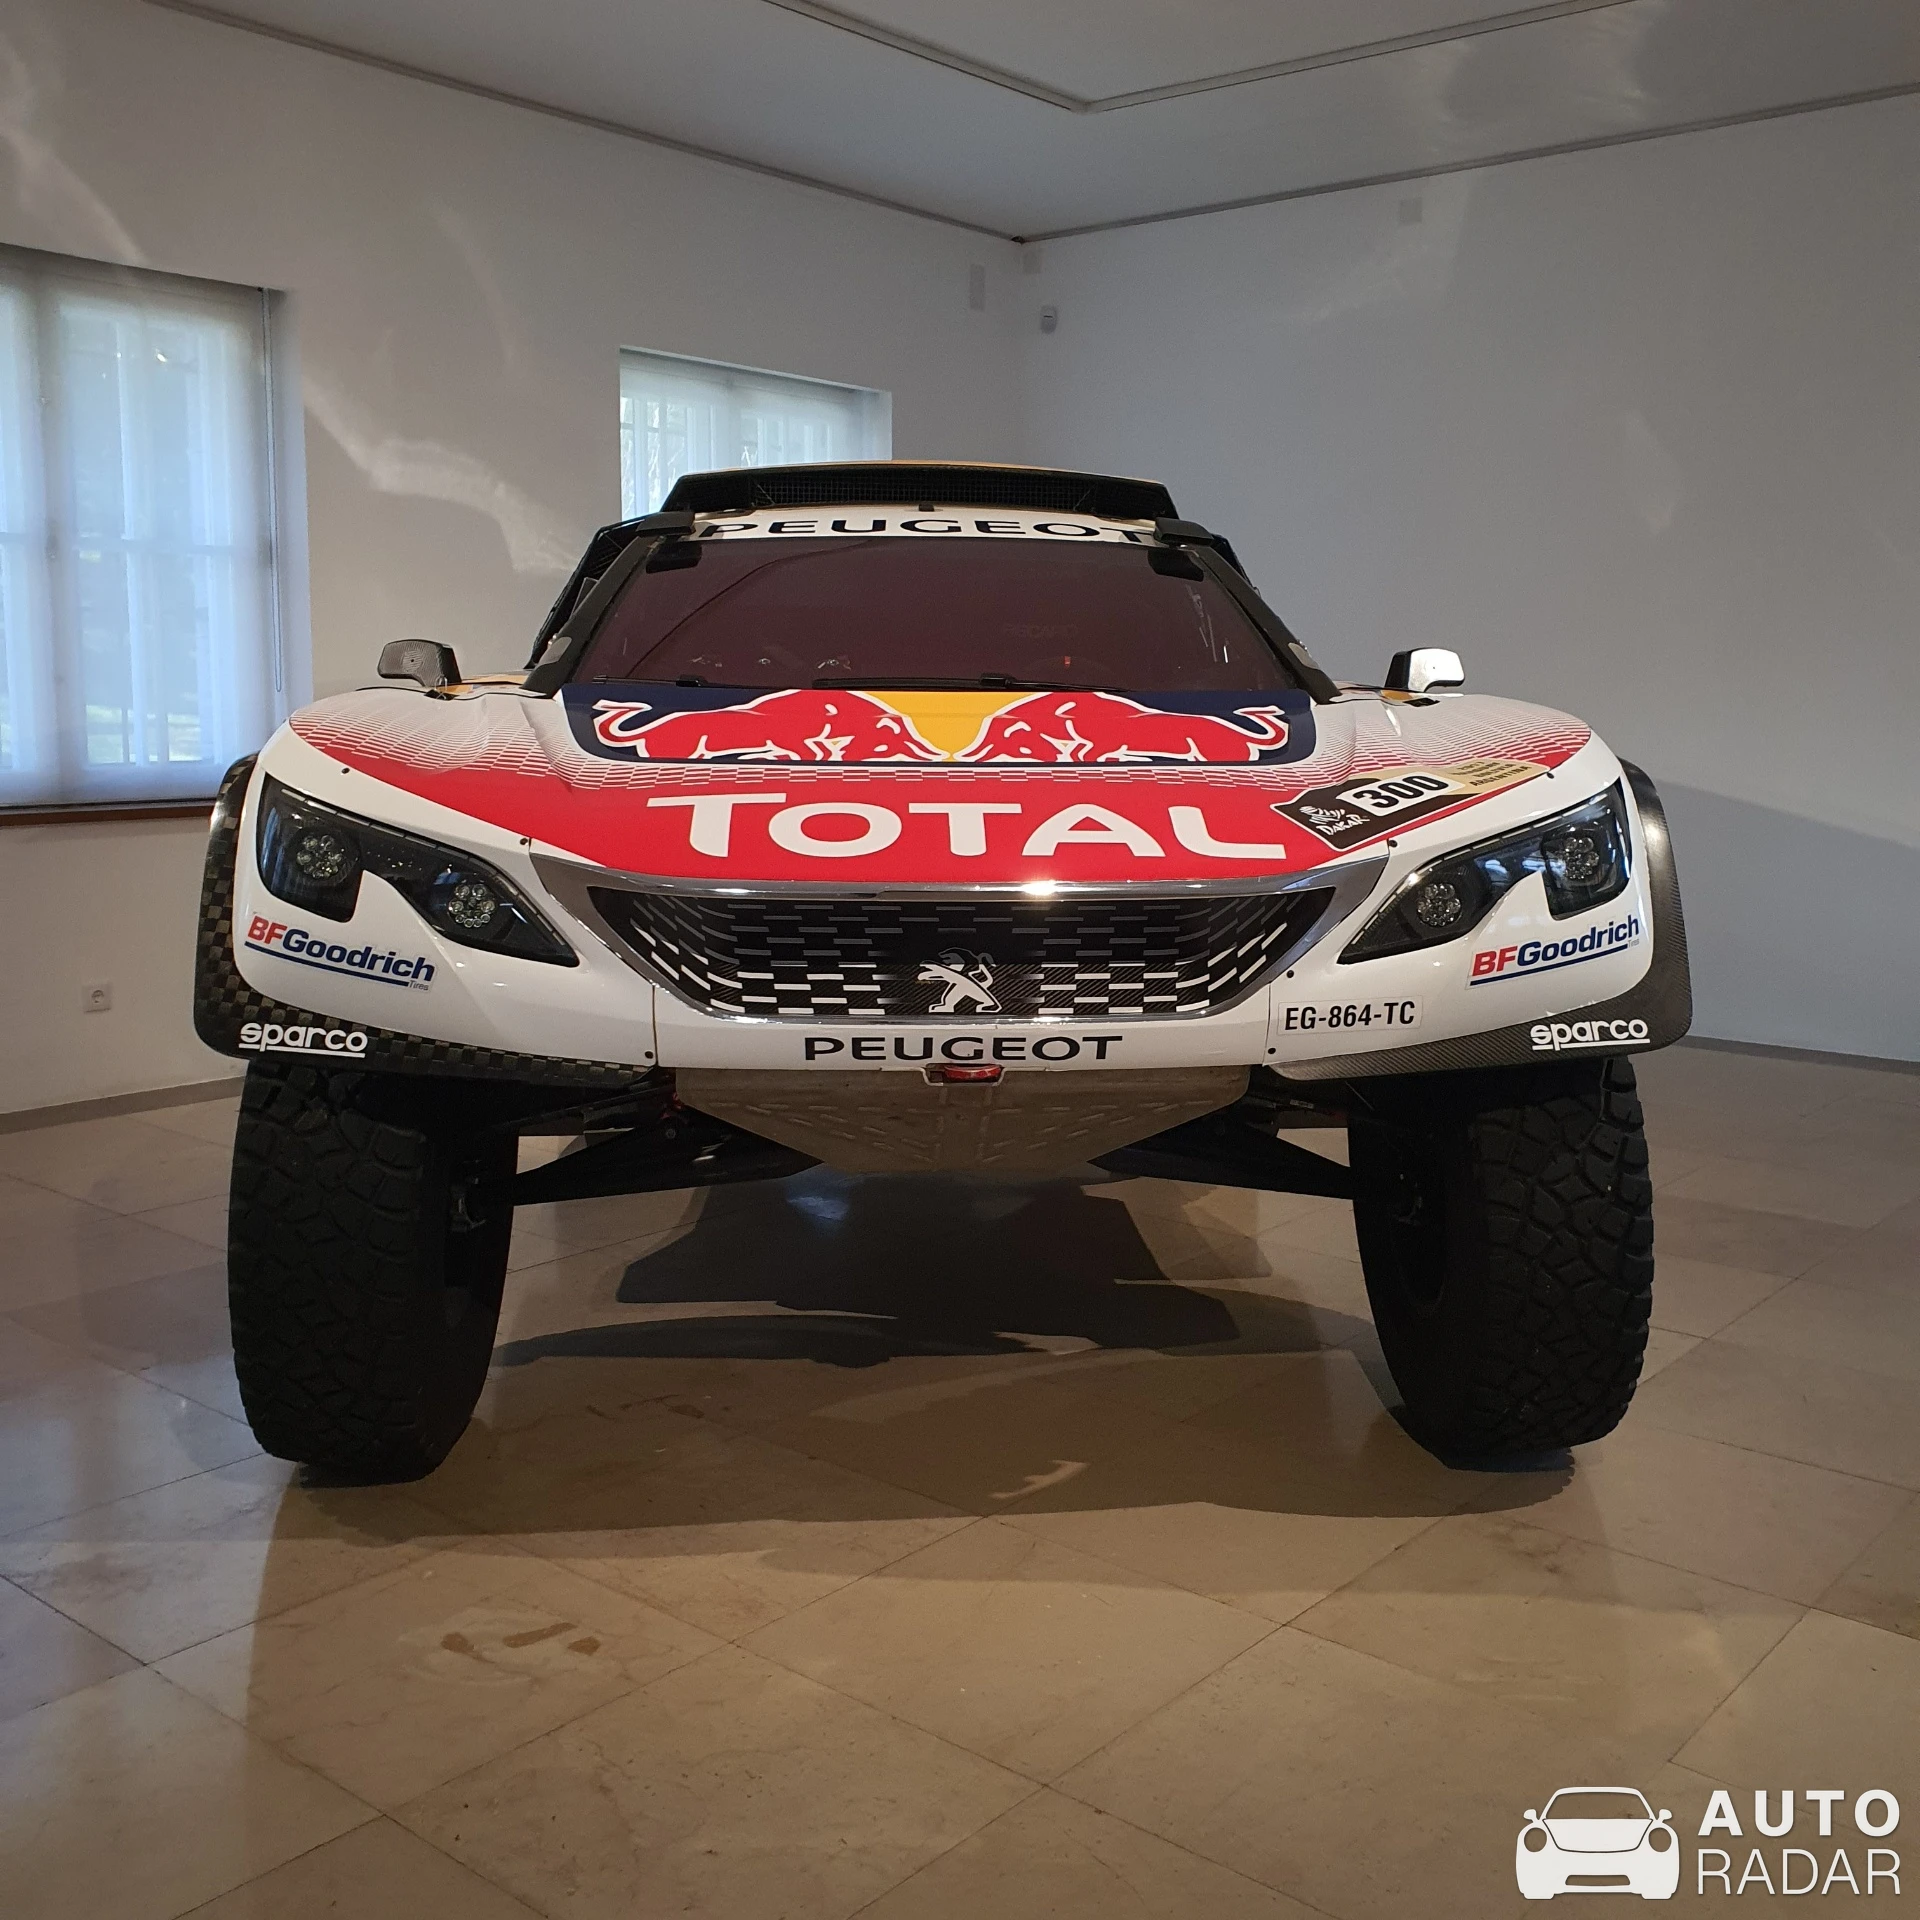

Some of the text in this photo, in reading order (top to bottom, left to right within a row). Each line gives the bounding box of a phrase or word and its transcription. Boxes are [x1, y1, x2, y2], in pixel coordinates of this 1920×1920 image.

[699, 519, 1154, 543] PEUGEOT
[1469, 765, 1532, 787] ARGENTINA
[1353, 775, 1449, 809] 300
[646, 792, 1287, 860] TOTAL
[1316, 813, 1370, 836] DAKAR
[247, 915, 435, 982] BFGoodrich
[1472, 914, 1639, 977] BFGoodrich
[408, 979, 429, 991] Tires
[1284, 1000, 1415, 1031] EG-864-TC
[239, 1021, 368, 1053] sparco
[804, 1035, 1123, 1062] PEUGEOT
[1530, 1018, 1648, 1051] sparco
